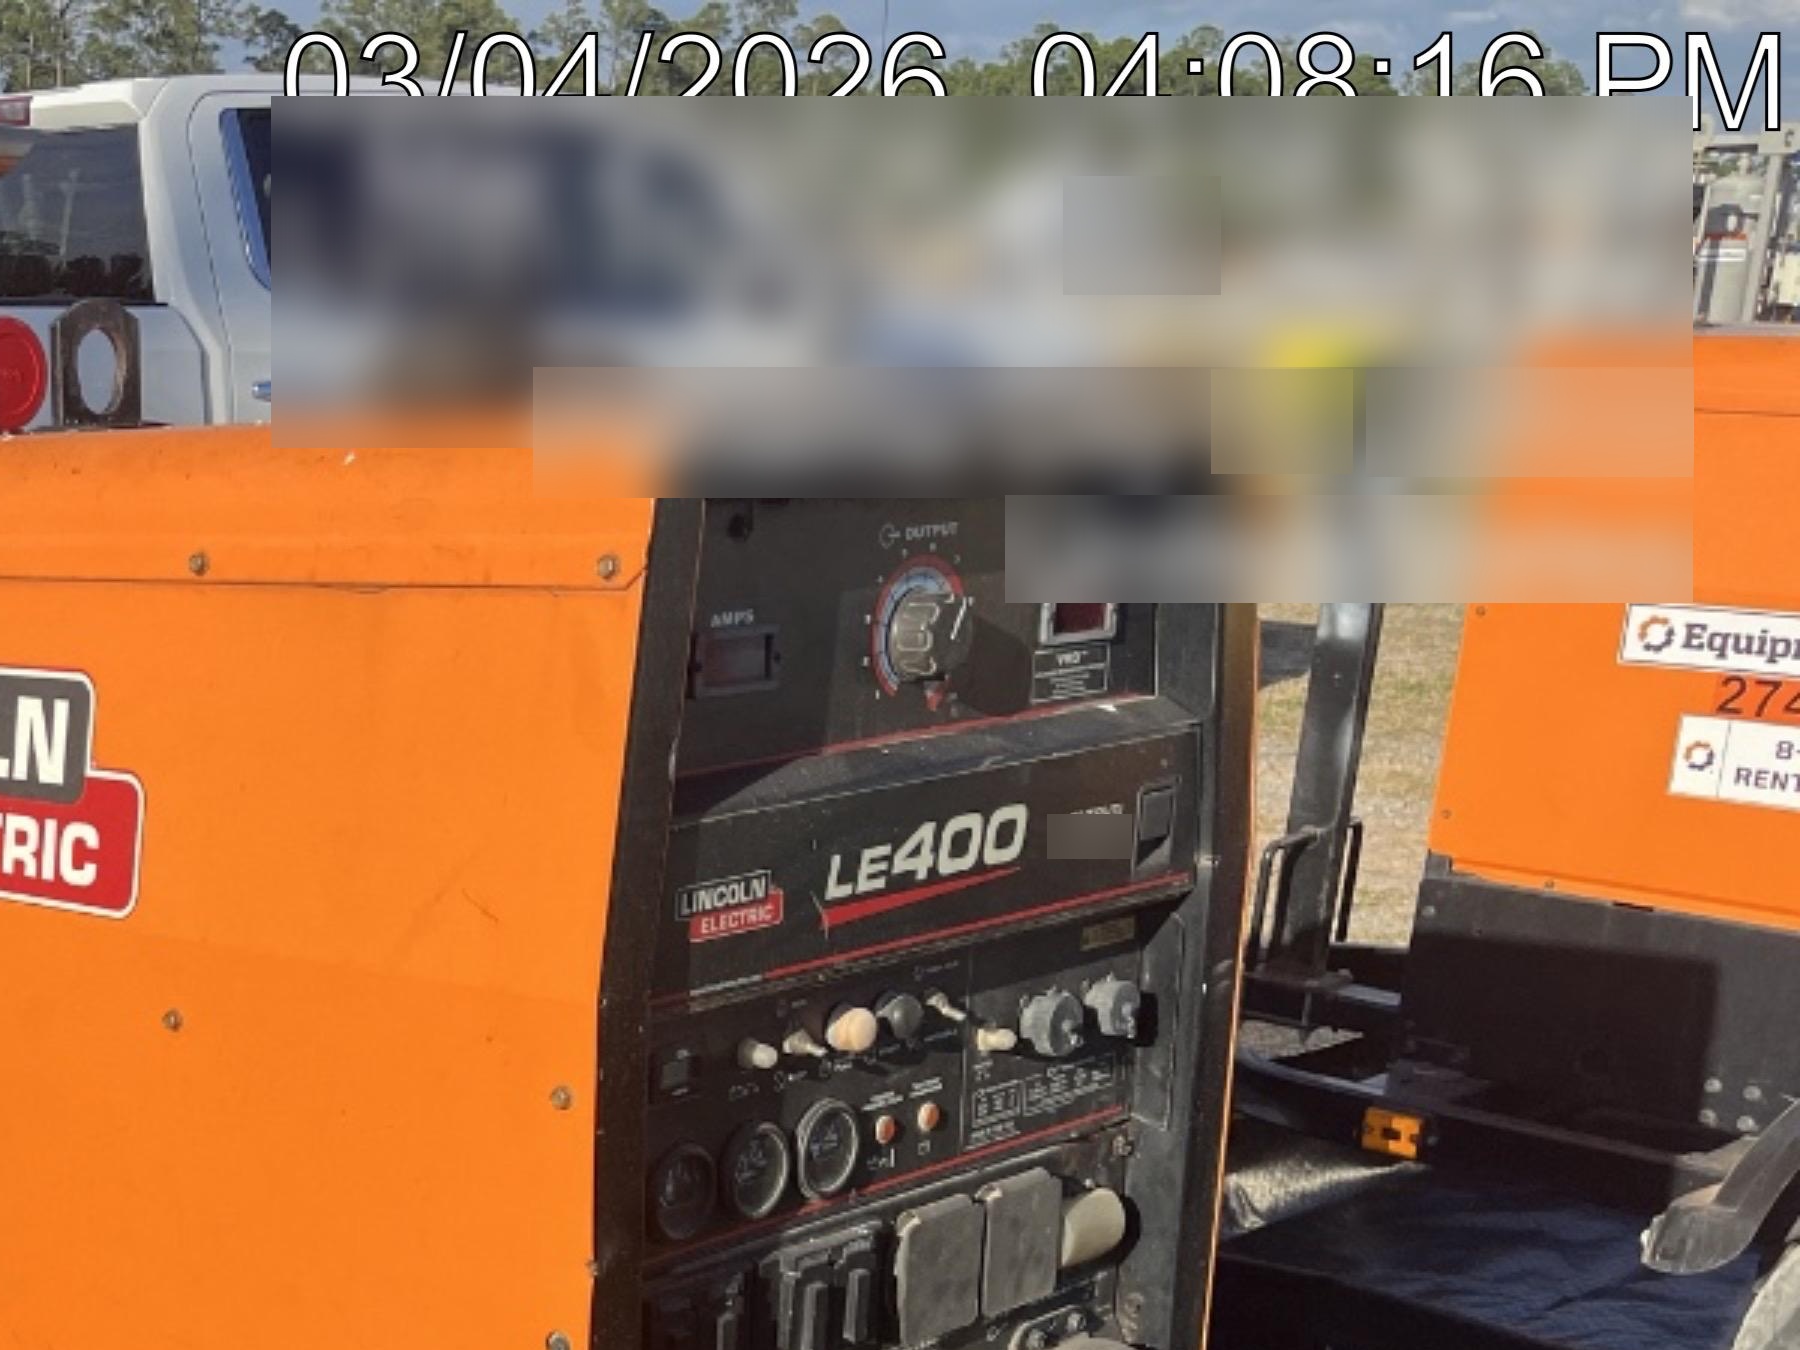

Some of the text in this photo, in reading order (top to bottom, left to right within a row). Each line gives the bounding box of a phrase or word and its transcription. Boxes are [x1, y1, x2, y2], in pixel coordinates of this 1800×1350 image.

[905, 521, 959, 541] OUTPUT
[710, 608, 755, 629] AMPS
[824, 803, 1029, 900] LE400
[680, 875, 767, 917] LINCOLN
[700, 903, 775, 935] ELECTRIC
